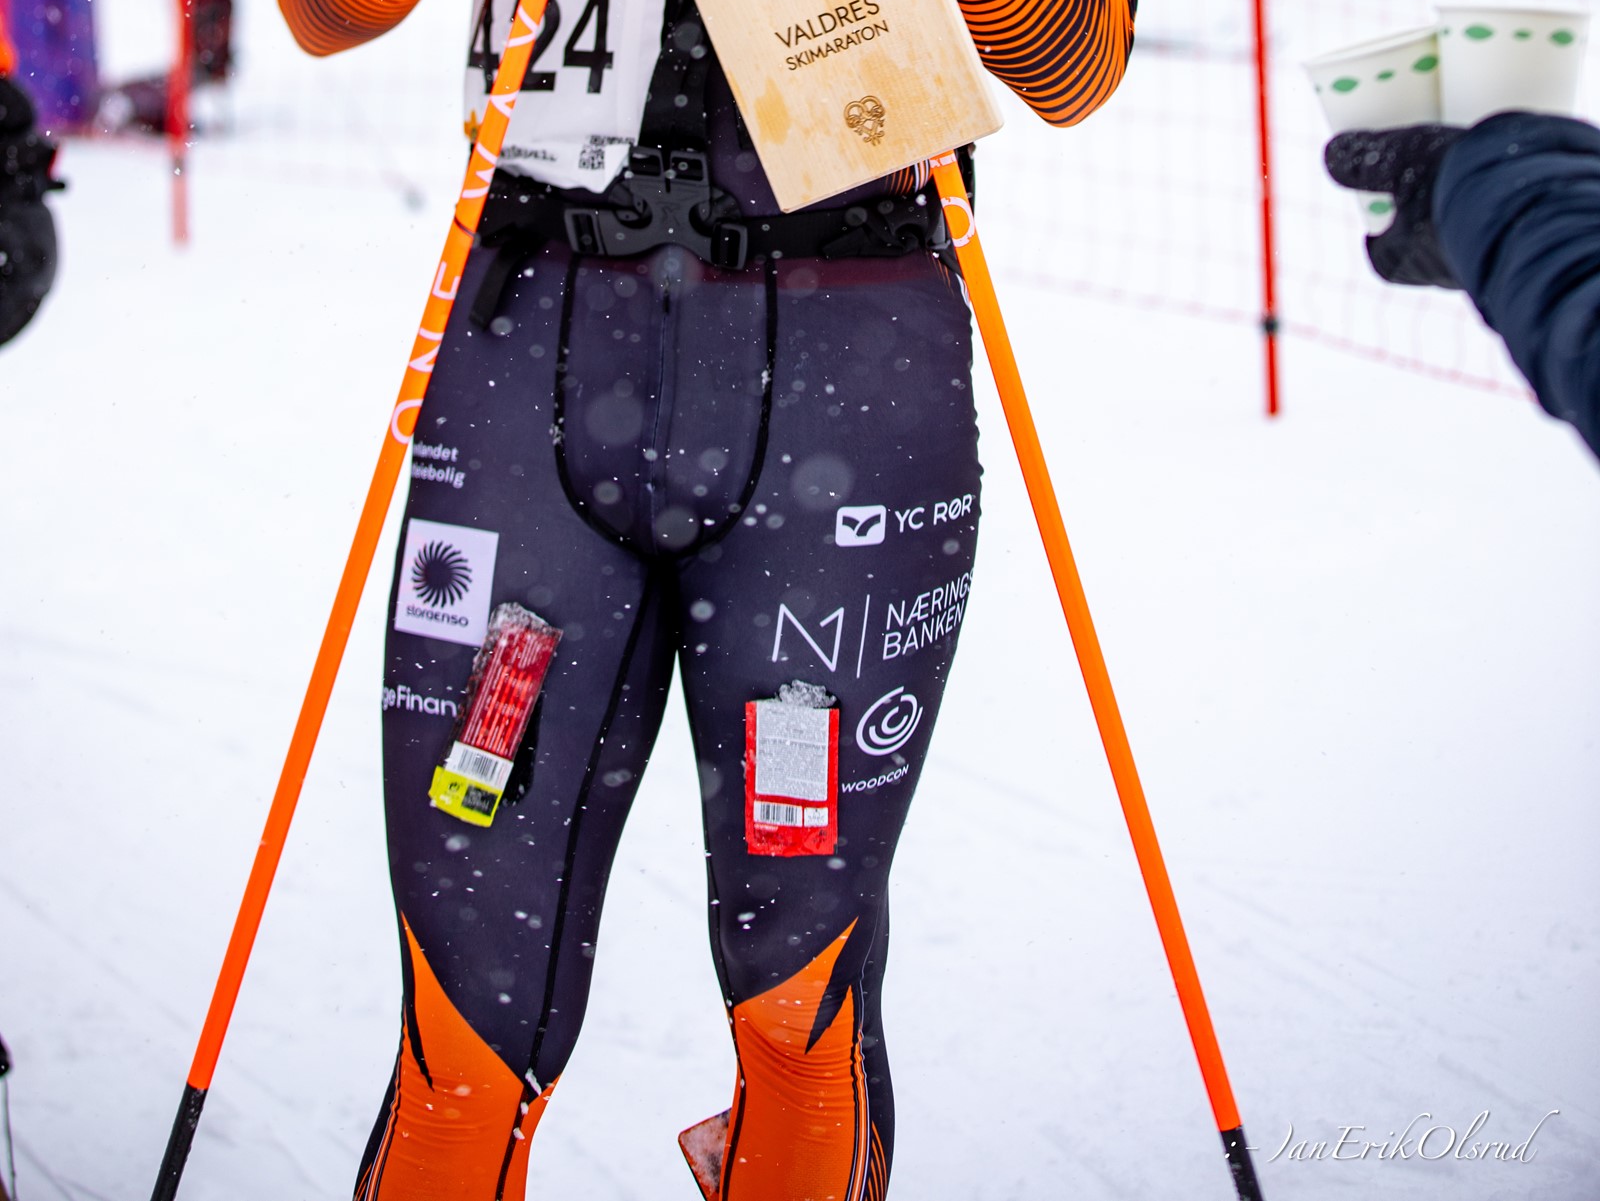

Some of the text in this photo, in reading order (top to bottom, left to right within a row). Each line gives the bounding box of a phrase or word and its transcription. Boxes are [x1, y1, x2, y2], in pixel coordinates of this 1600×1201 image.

[785, 20, 890, 71] SKIMARATON
[895, 493, 973, 533] YC RØR
[882, 599, 965, 660] BANKEN
[841, 764, 909, 793] WOODCON
